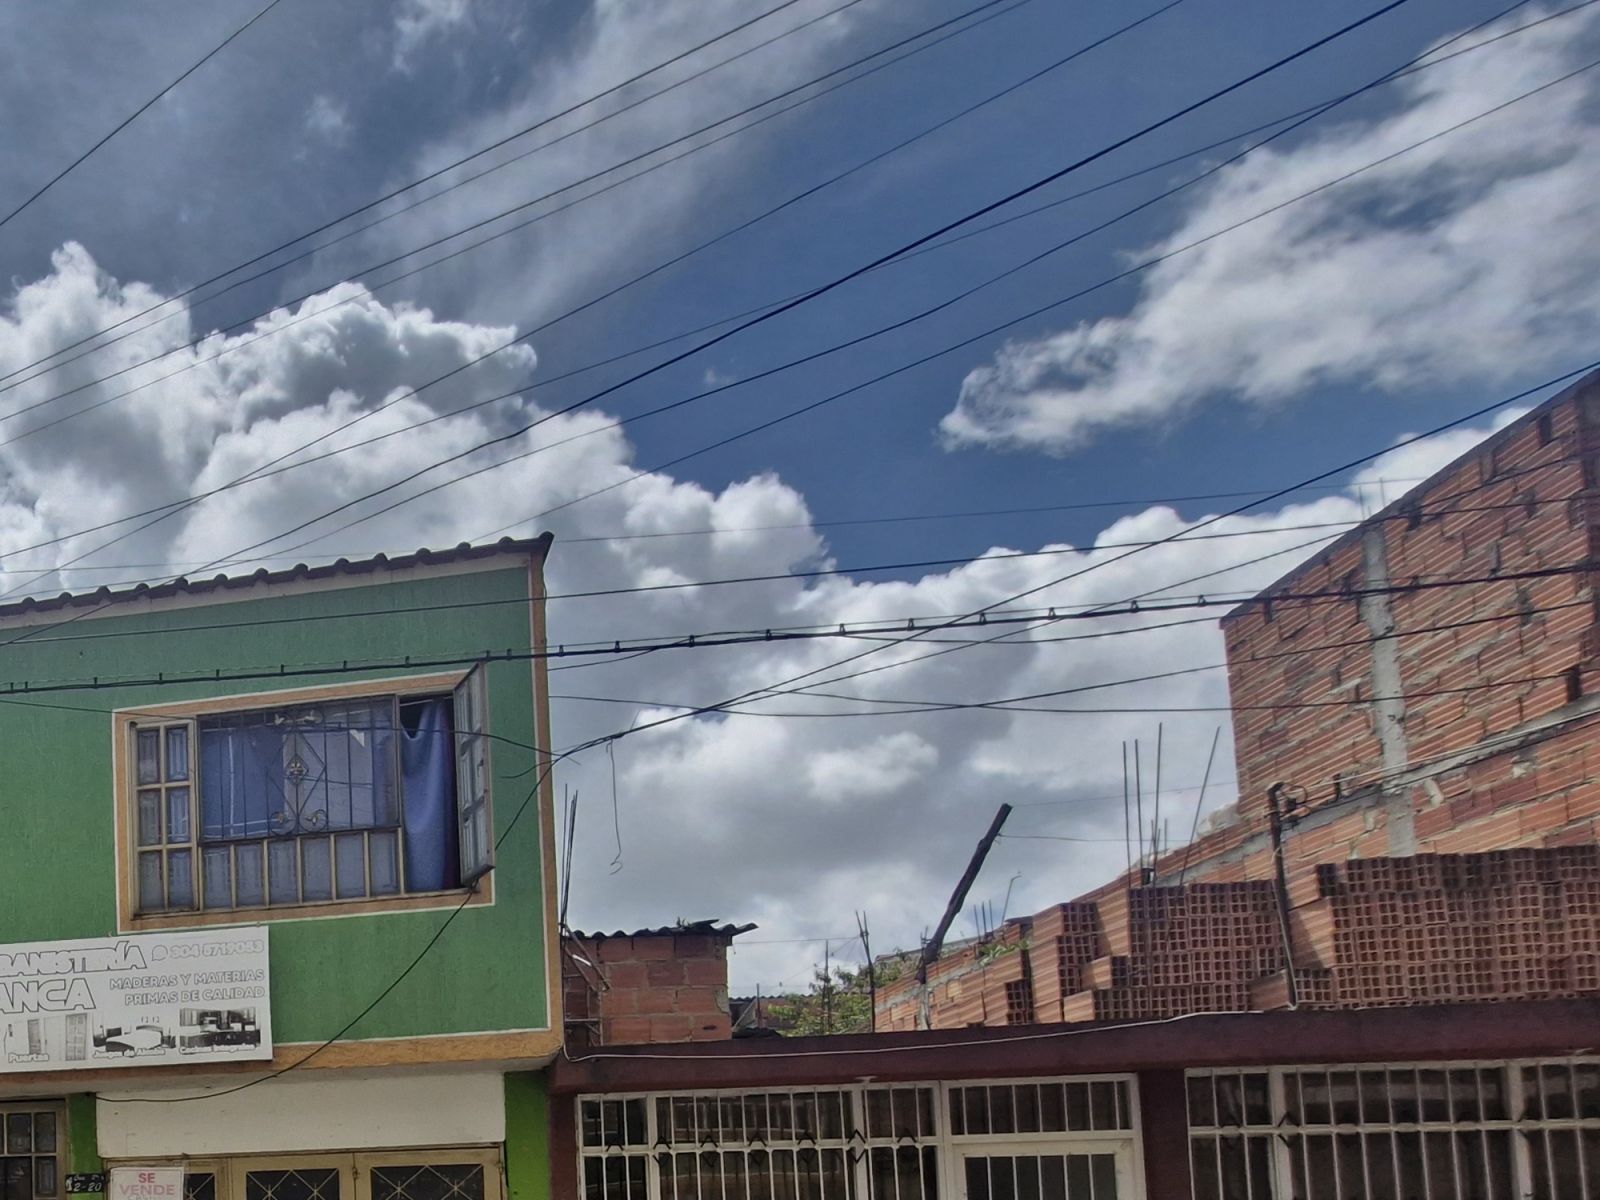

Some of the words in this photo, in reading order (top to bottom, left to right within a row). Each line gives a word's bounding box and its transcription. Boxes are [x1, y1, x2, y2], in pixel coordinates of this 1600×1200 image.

[110, 974, 178, 990] MADERAS
[179, 973, 191, 985] Y
[193, 969, 265, 985] MATERIAS
[125, 990, 178, 1006] PRIMAS
[181, 989, 200, 1002] DE
[202, 986, 265, 1001] CALIDAD
[8, 1052, 49, 1063] Puertas
[138, 1172, 156, 1183] SE
[119, 1184, 175, 1195] VENDE
